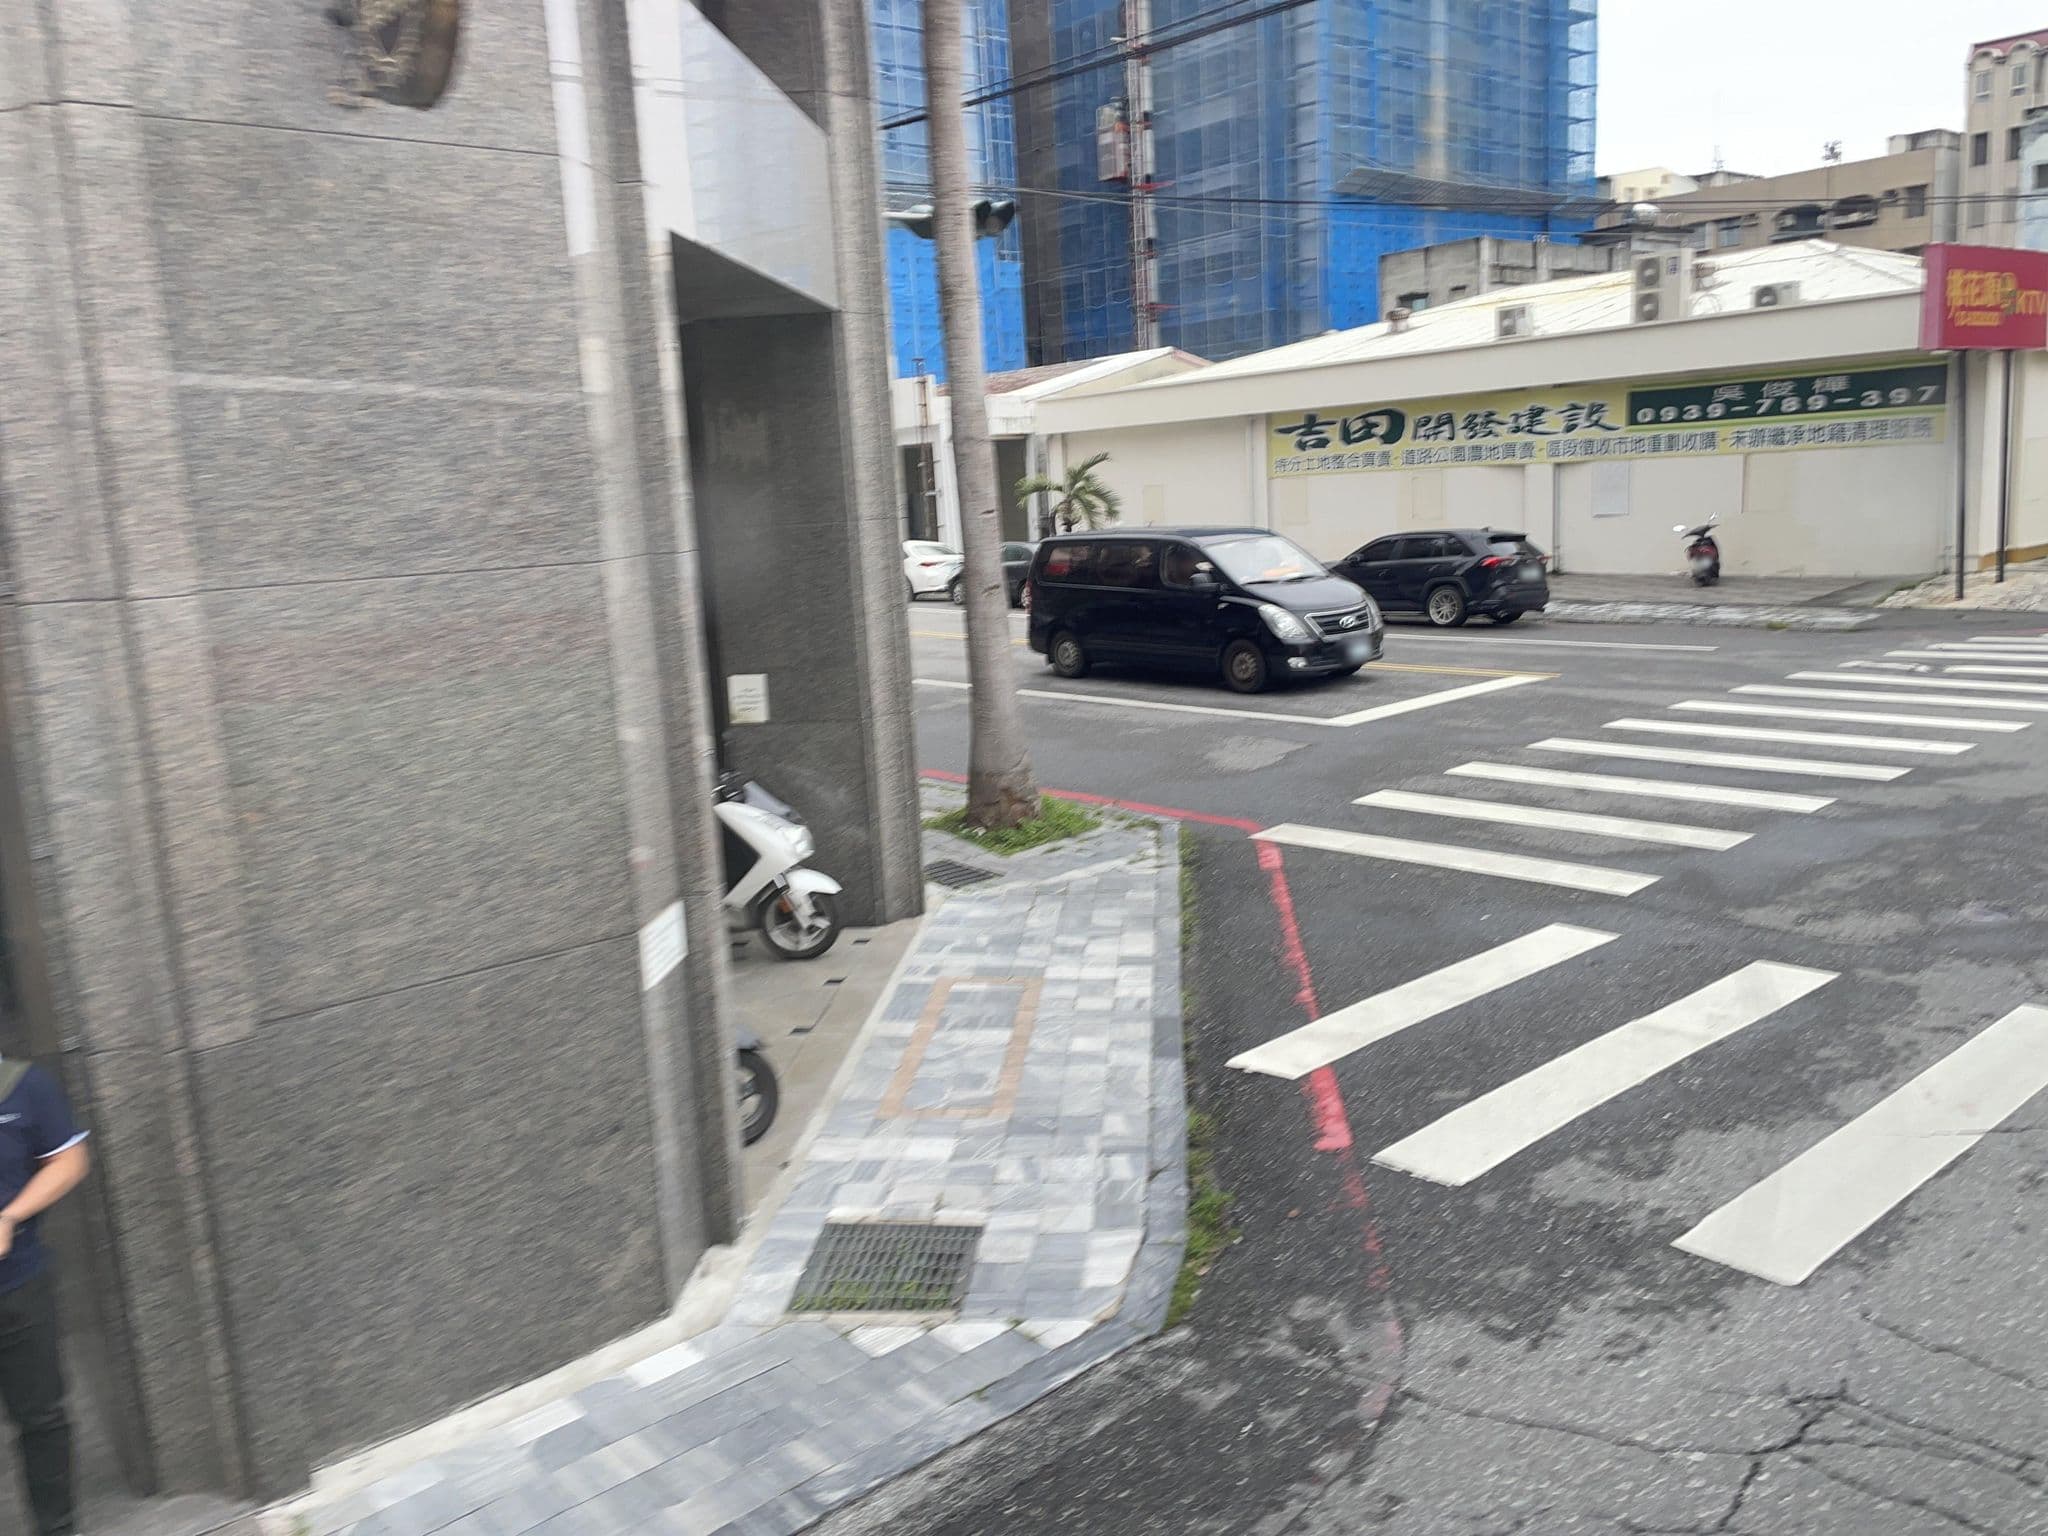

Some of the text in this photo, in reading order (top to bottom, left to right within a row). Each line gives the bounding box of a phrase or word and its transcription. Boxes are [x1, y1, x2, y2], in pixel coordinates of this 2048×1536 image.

[1274, 401, 1621, 452] 吉田開發建設
